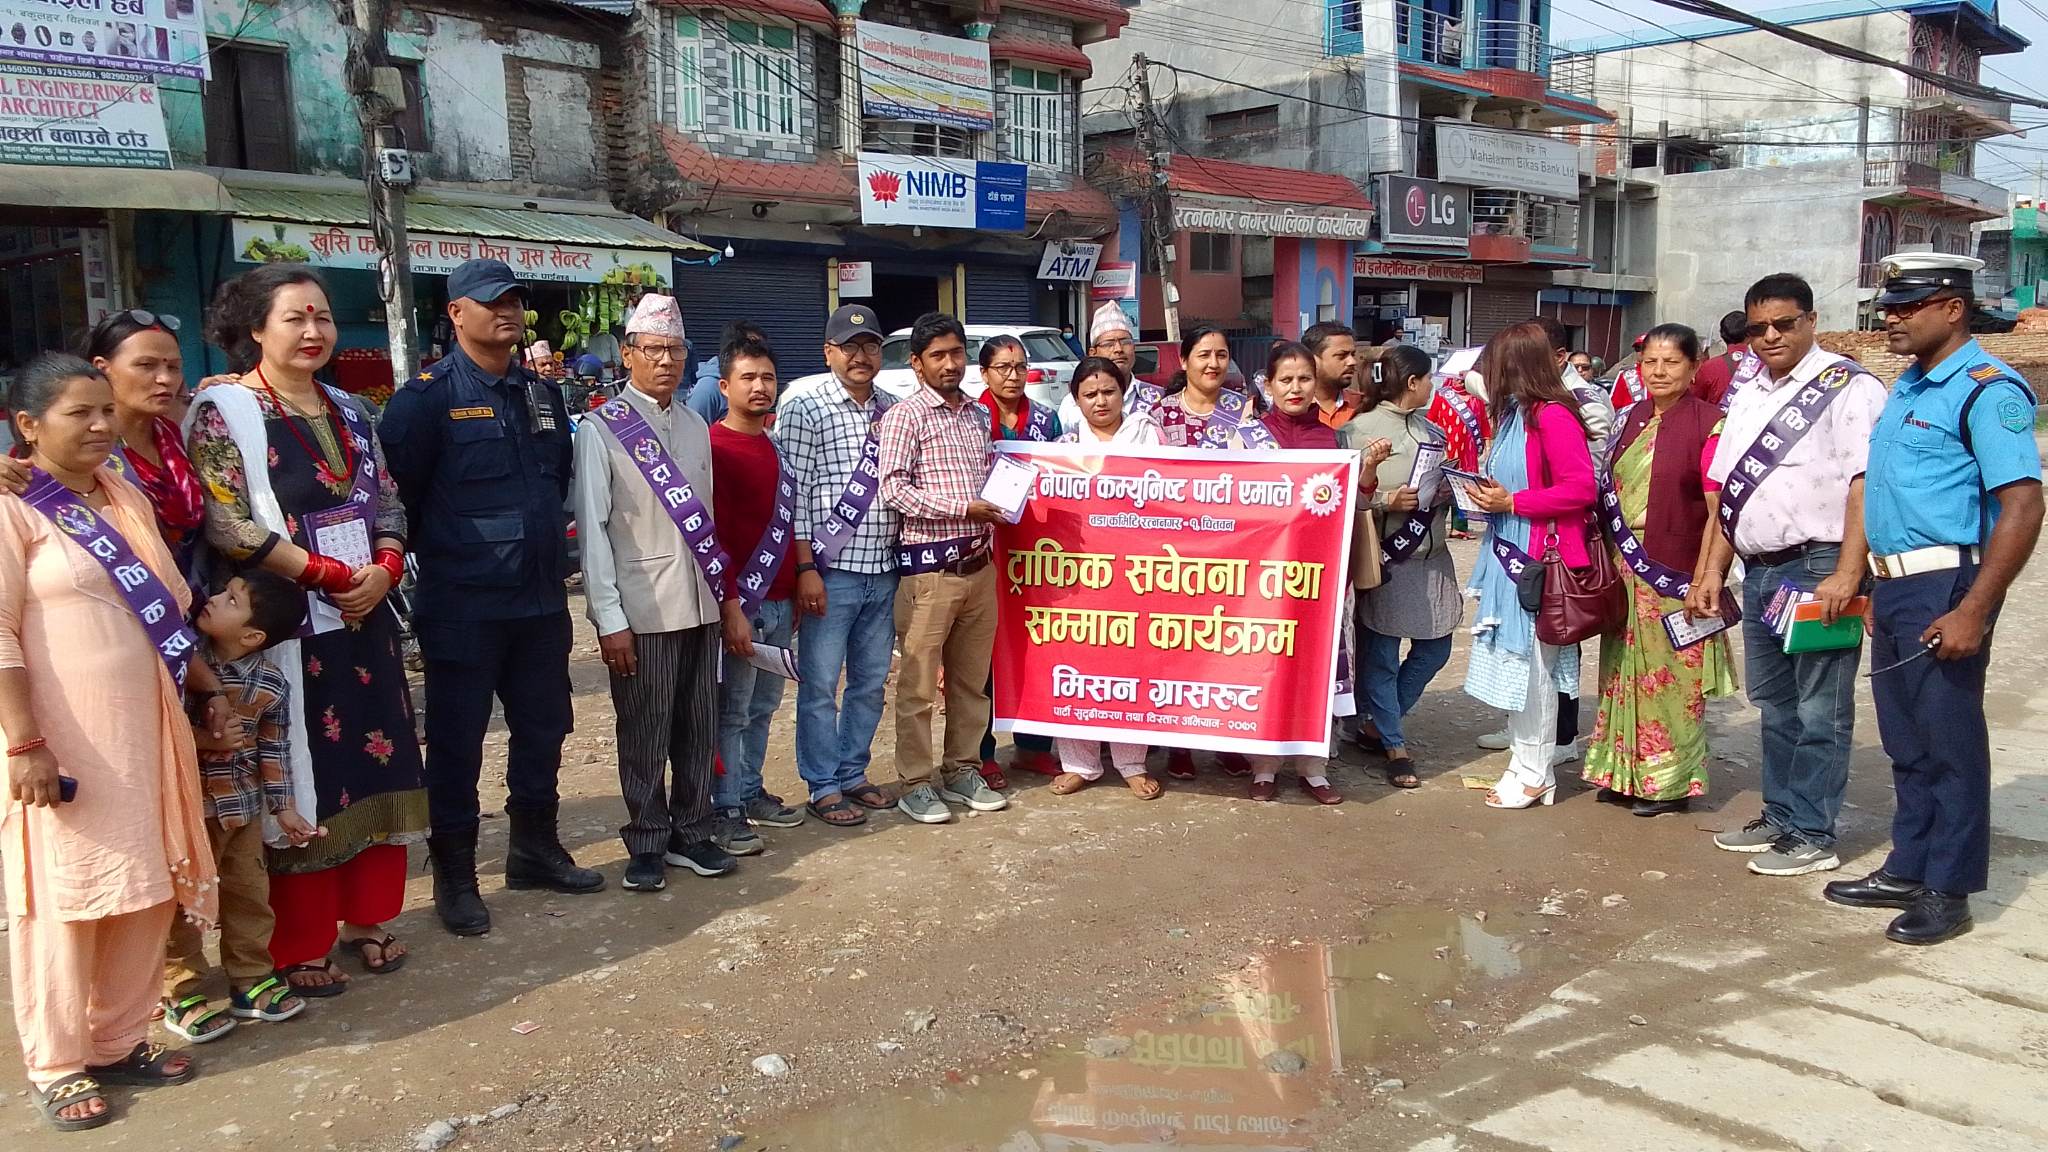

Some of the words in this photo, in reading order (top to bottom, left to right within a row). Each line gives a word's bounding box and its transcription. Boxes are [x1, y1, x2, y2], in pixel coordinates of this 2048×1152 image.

[950, 52, 987, 72] Consultancy
[16, 78, 134, 103] ENGINEERING
[140, 87, 154, 104] &
[0, 97, 100, 120] ARCHITECT
[49, 126, 112, 146] बनाउने
[1470, 148, 1515, 167] Mahalaxmi
[1518, 157, 1538, 172] Bikas
[1541, 160, 1560, 174] Bank
[906, 170, 967, 198] NIMB
[1174, 206, 1236, 235] रत्ननगर
[1238, 208, 1316, 236] नगरपालिका
[1317, 212, 1369, 236] कार्यालय
[1432, 194, 1456, 225] LG
[309, 226, 352, 258] खुसि
[438, 240, 471, 260] एण्ड
[516, 246, 544, 270] जुस
[550, 246, 594, 270] सेन्टर
[1046, 257, 1090, 278] ATM
[1039, 467, 1091, 500] नेपाल
[1096, 469, 1188, 508] कम्युनिष्ट
[1193, 474, 1233, 505] पार्टी
[1238, 474, 1294, 508] एमाले
[1089, 514, 1107, 526] वडा
[1108, 512, 1139, 528] कमिटि
[1202, 516, 1234, 531] चितवन
[1008, 538, 1116, 596] ट्राफिक
[1125, 544, 1250, 597] सचेतना
[1258, 558, 1325, 600] तथा
[1024, 605, 1140, 648] सम्मान
[1148, 606, 1298, 658] कार्यक्रम
[1052, 664, 1140, 703] मिसन
[1054, 704, 1072, 716] पार्टी
[1125, 712, 1144, 722] तथा
[1146, 710, 1178, 724] विस्तार
